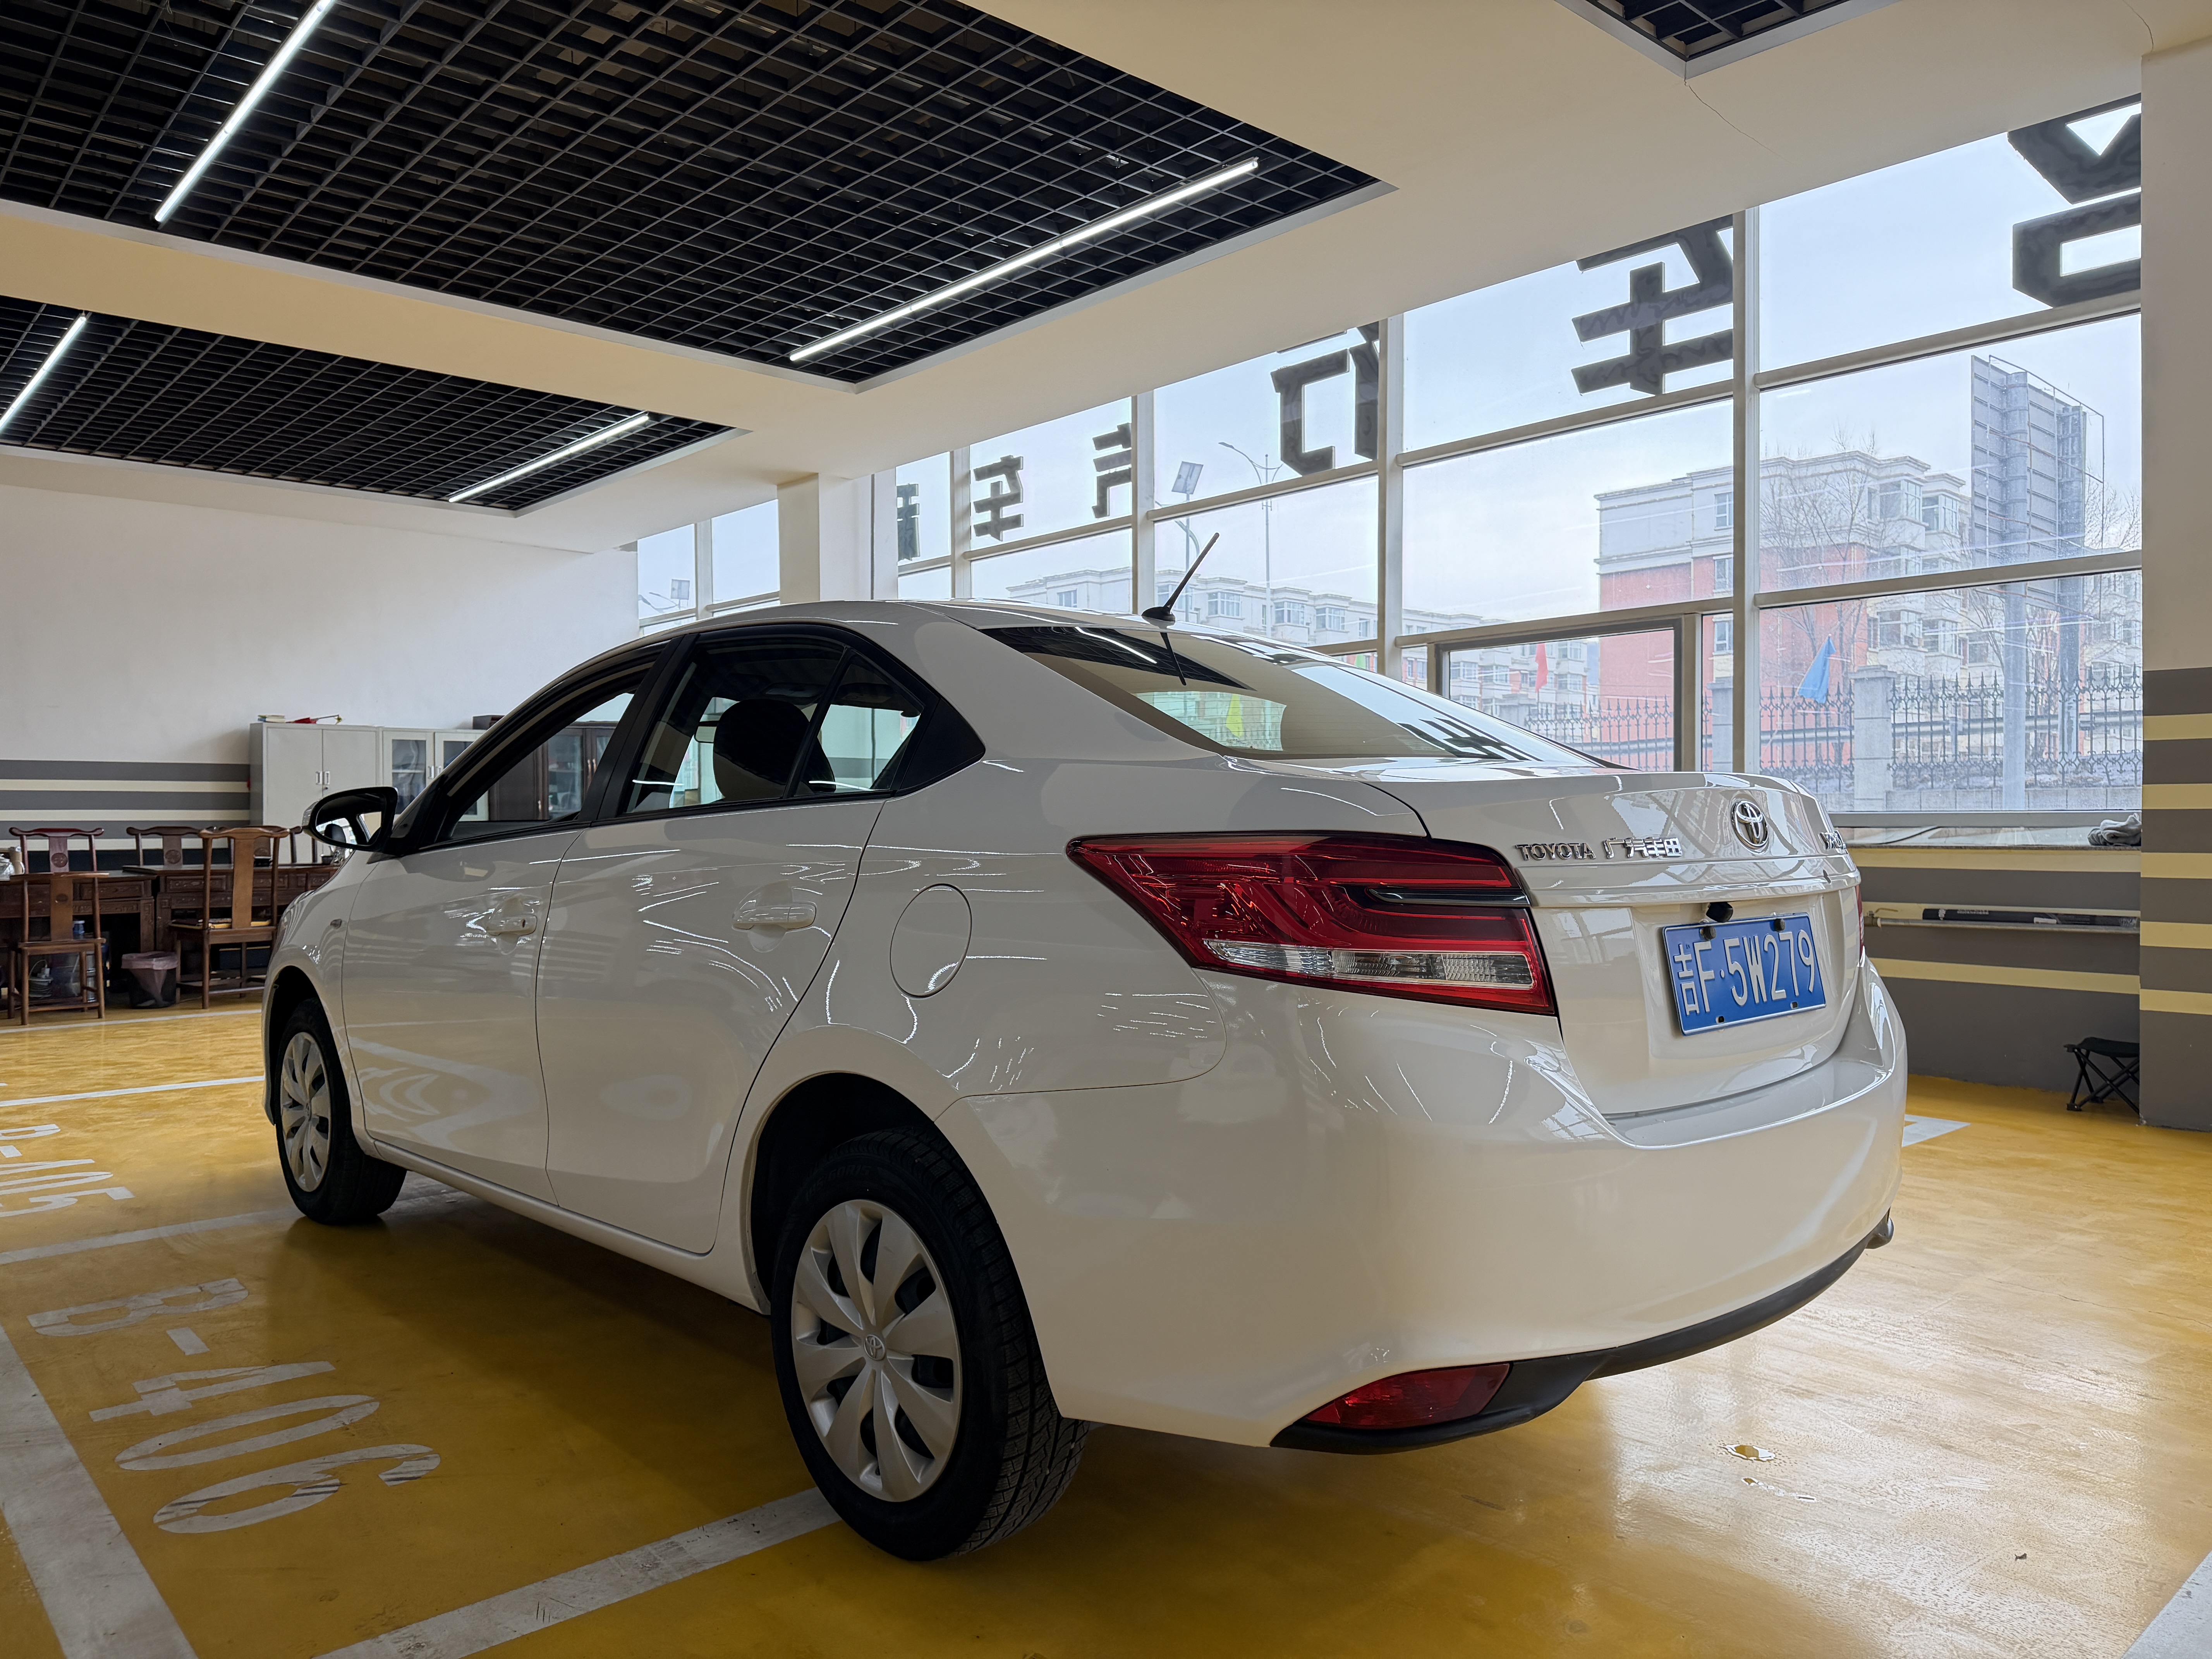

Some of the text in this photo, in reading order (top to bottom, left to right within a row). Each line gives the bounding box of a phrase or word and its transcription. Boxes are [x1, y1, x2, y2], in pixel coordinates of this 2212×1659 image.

[1515, 837, 1683, 860] TOYOTA 广汽丰田
[1674, 929, 1814, 1016] 吉F·5W279
[27, 1278, 441, 1534] B-406
